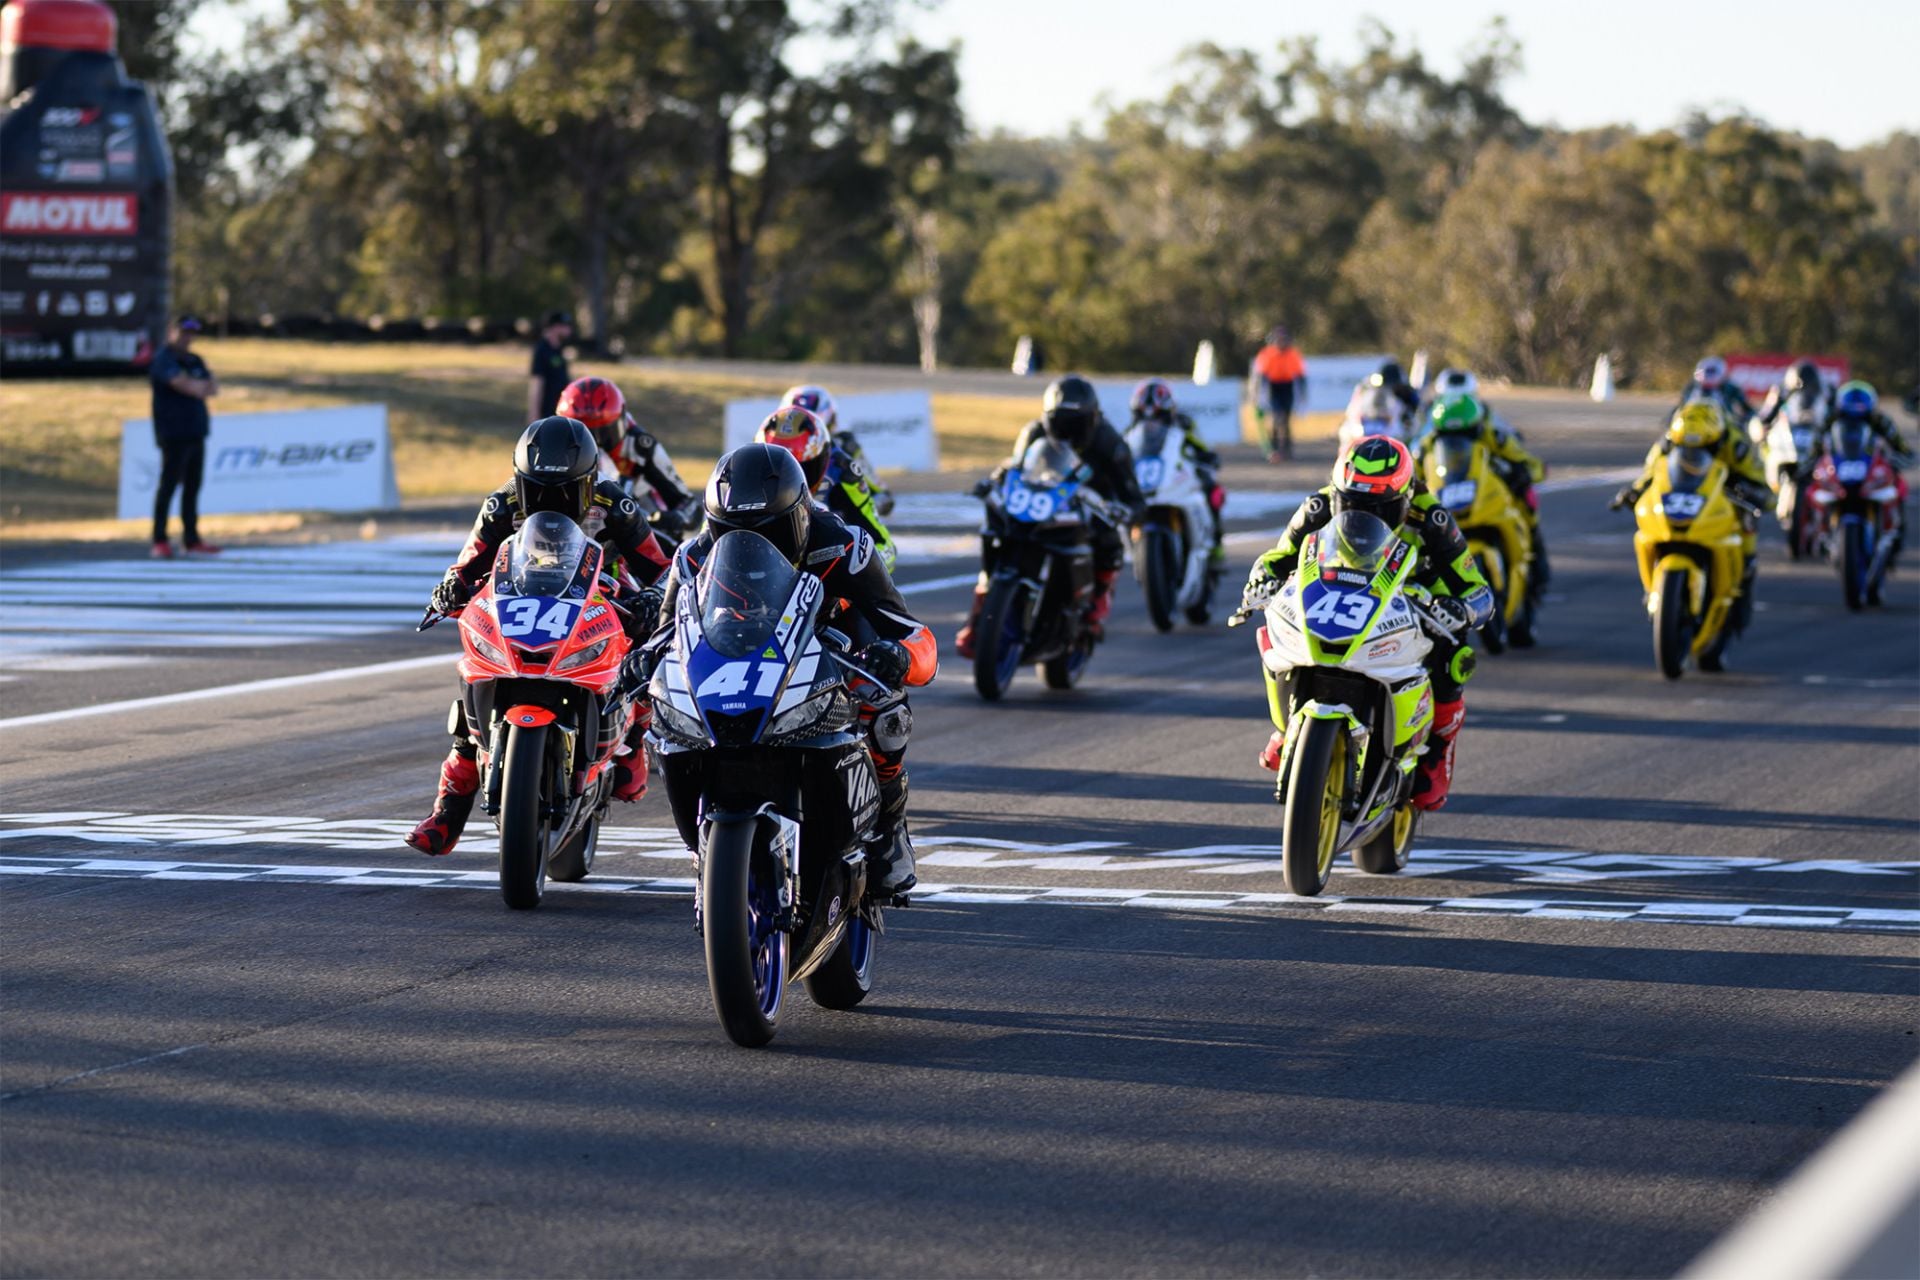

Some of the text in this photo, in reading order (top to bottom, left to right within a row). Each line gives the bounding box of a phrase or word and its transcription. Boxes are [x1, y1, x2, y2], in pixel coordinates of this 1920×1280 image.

[5, 196, 131, 229] MOTUL
[726, 502, 767, 513] LS2
[1007, 488, 1054, 522] 99
[501, 598, 571, 640] 34
[1305, 590, 1374, 630] 43
[1375, 614, 1412, 633] YAMAHA
[577, 618, 614, 642] YAMAHA
[696, 661, 786, 698] 41
[721, 702, 747, 710] YAMAHA
